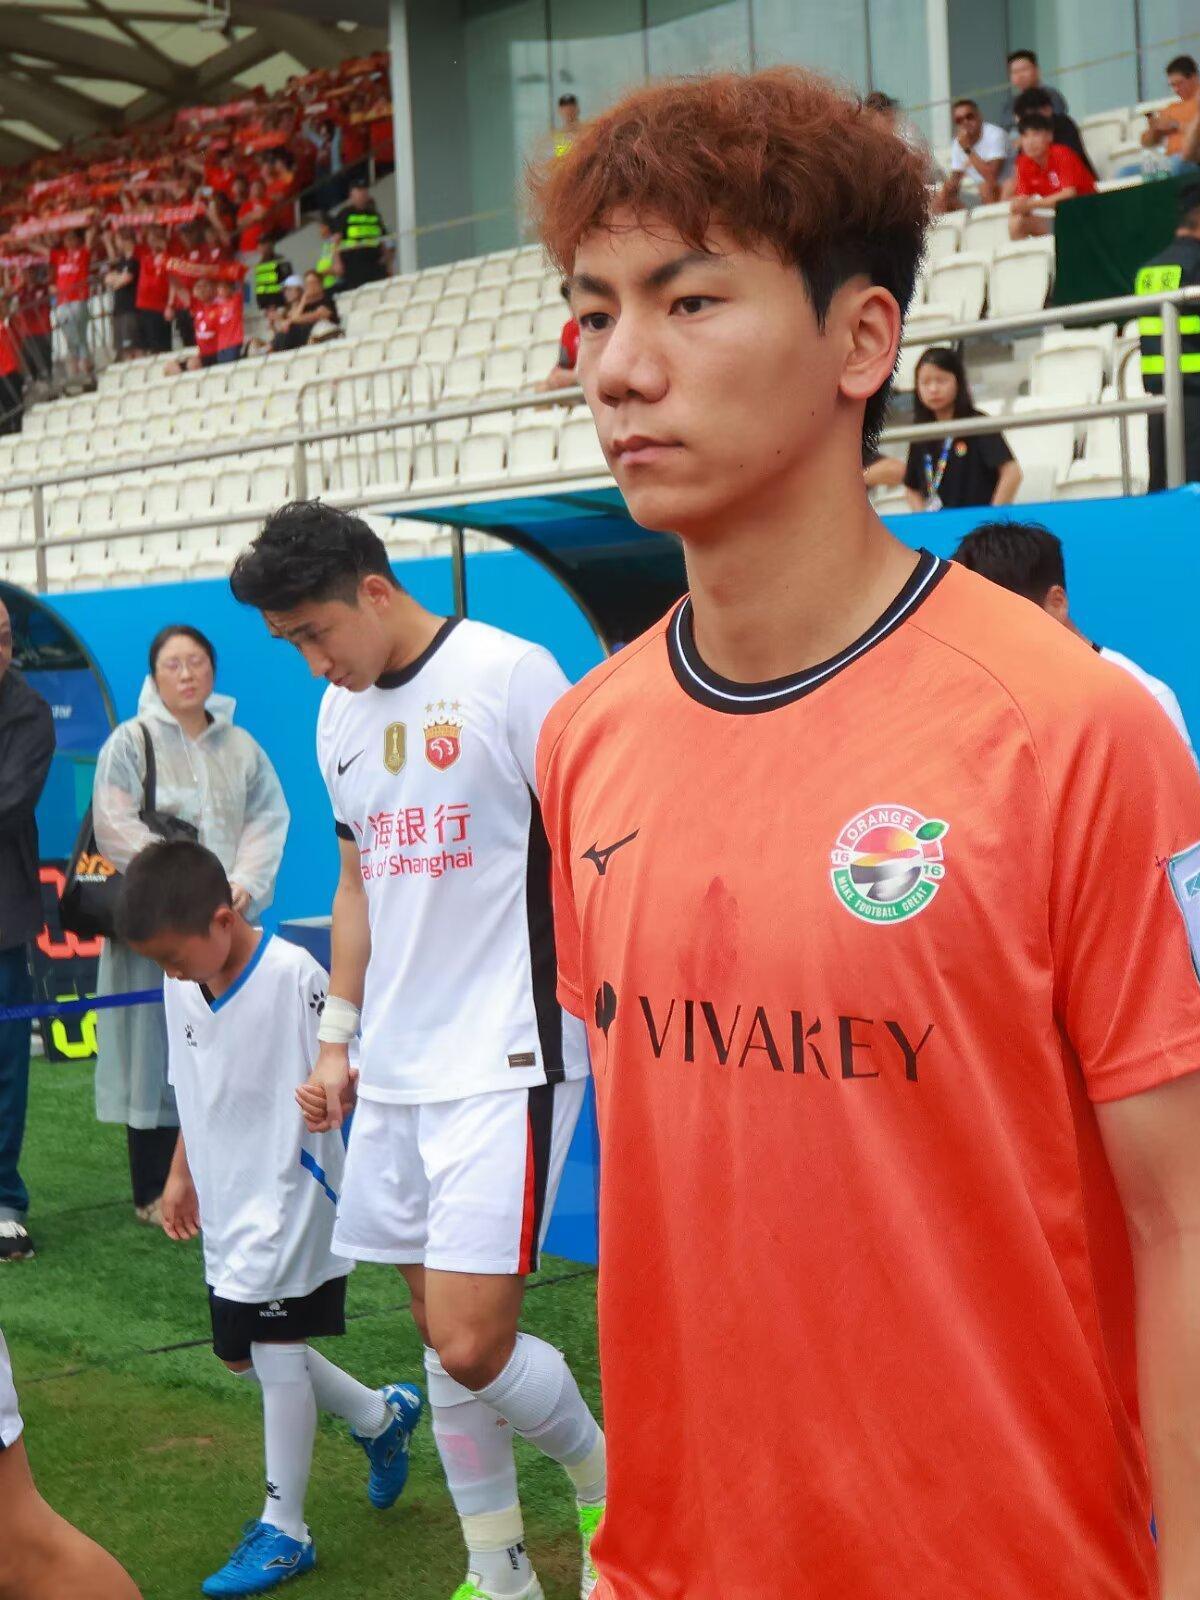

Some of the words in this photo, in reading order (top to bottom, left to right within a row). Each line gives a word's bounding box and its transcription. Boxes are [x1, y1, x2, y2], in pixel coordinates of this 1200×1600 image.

[847, 811, 913, 840] ORANGE
[389, 846, 473, 879] Shanghai
[834, 852, 850, 862] 16
[923, 865, 942, 876] 16
[837, 876, 855, 900] MAKE
[855, 901, 899, 917] FOOTBALL
[902, 887, 927, 911] GREAT
[637, 996, 935, 1083] VIVAKEY
